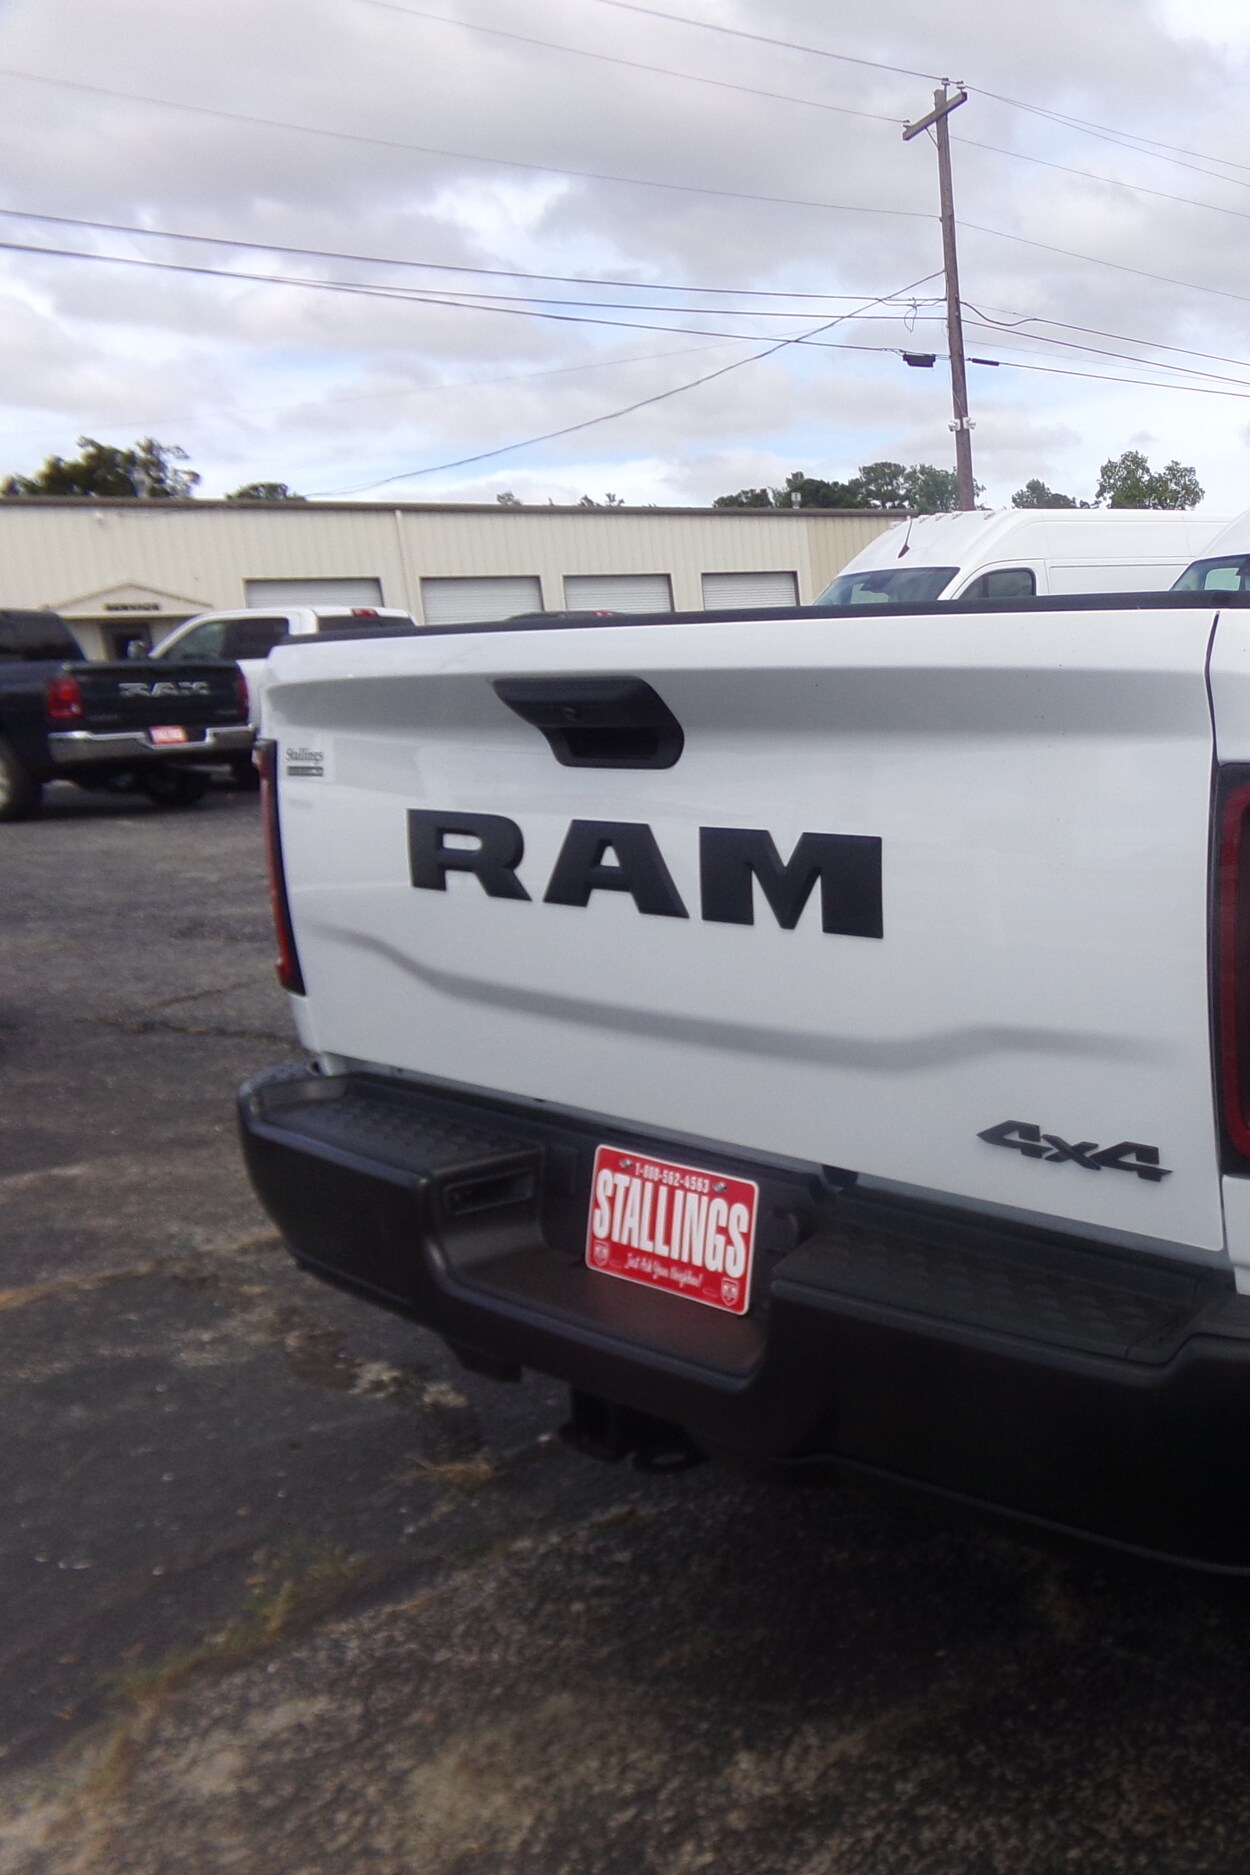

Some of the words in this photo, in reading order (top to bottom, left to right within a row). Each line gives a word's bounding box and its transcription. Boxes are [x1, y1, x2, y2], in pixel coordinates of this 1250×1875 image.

[118, 681, 210, 697] RAM
[285, 747, 324, 765] Stallings
[406, 808, 884, 939] RAM
[592, 1168, 750, 1279] STALLINGS
